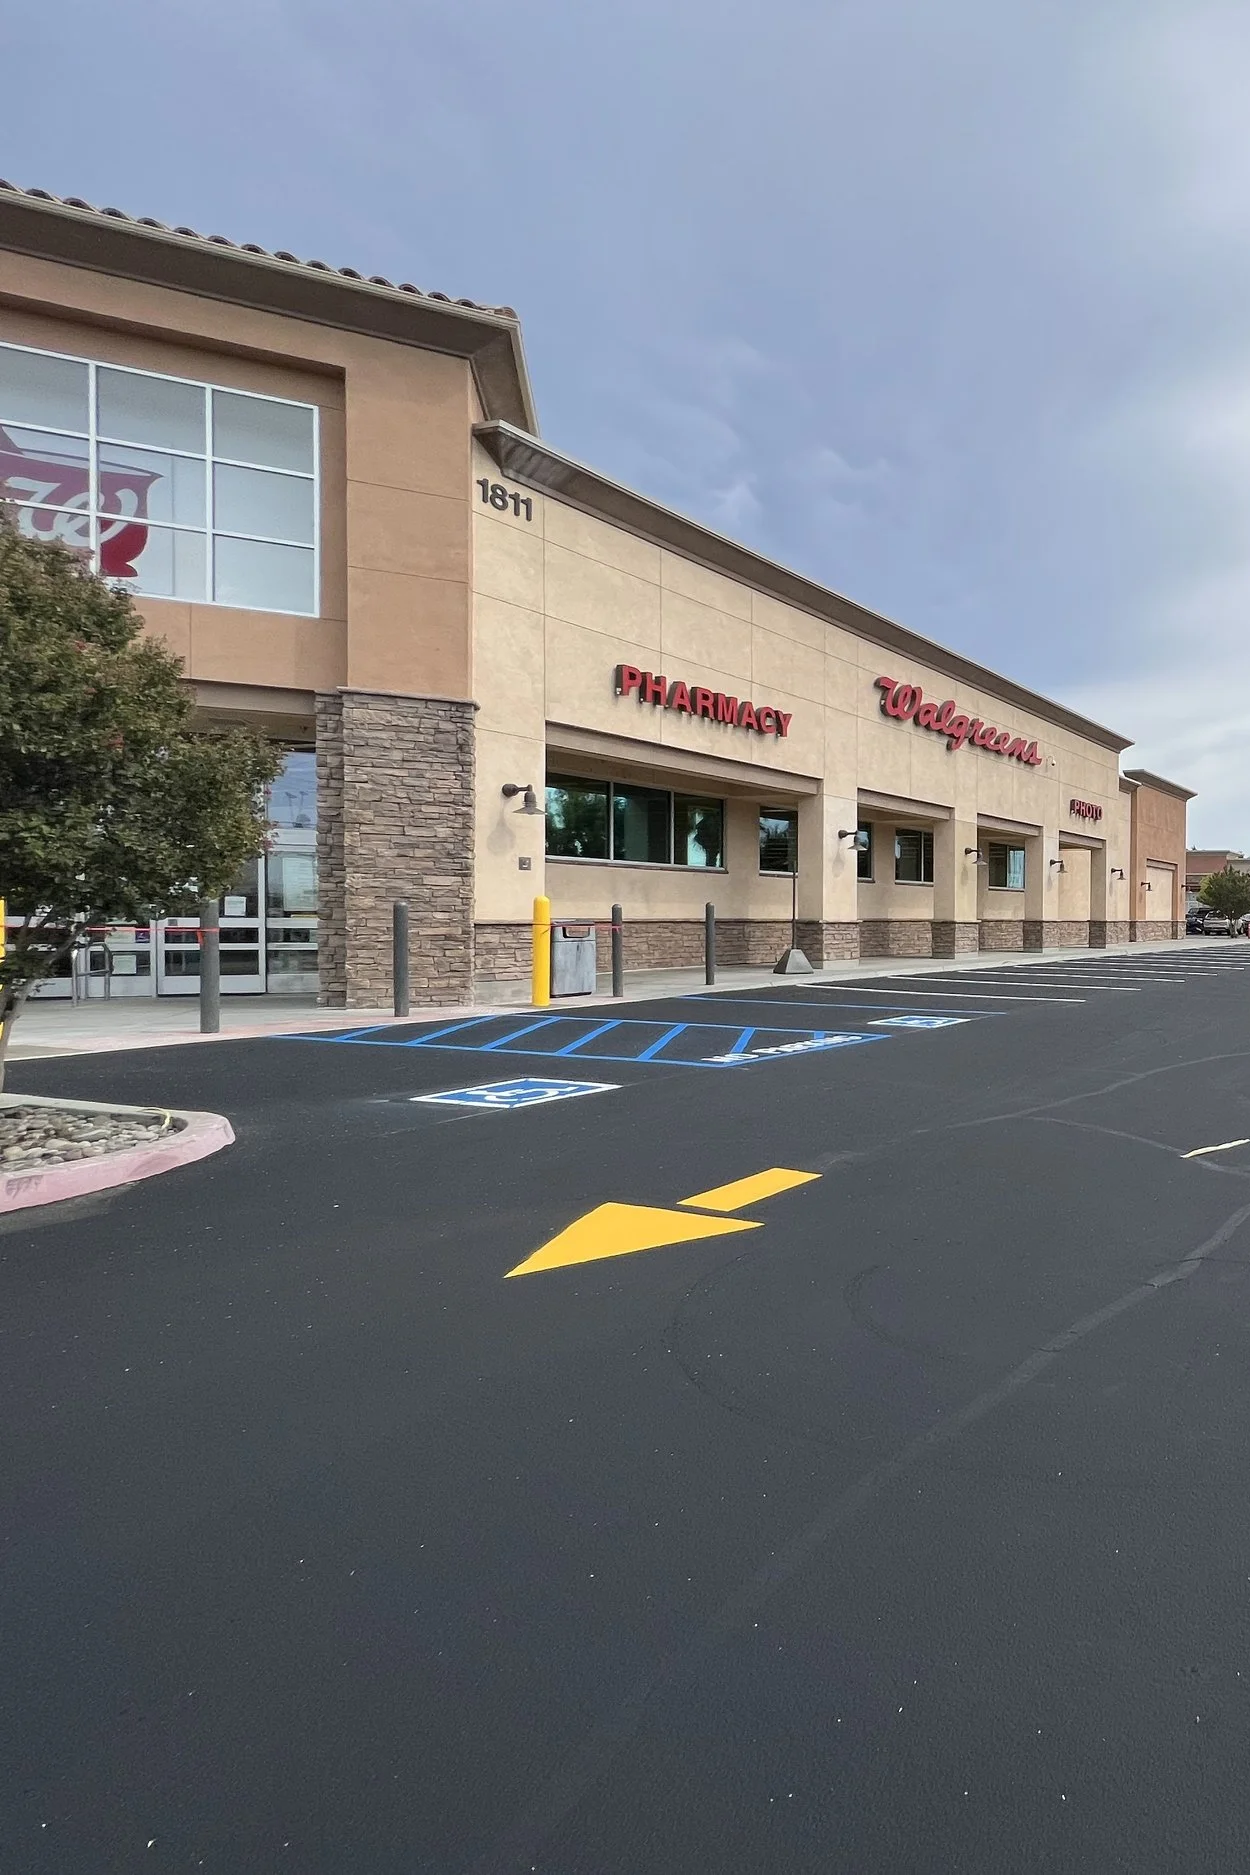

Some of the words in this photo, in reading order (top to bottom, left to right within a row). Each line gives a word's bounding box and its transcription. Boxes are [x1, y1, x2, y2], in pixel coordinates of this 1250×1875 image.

[476, 478, 532, 522] 1811
[616, 665, 792, 737] PHARMACY
[875, 676, 1042, 765] Walgreens
[1071, 799, 1102, 820] PHOTO
[701, 1053, 759, 1063] NO
